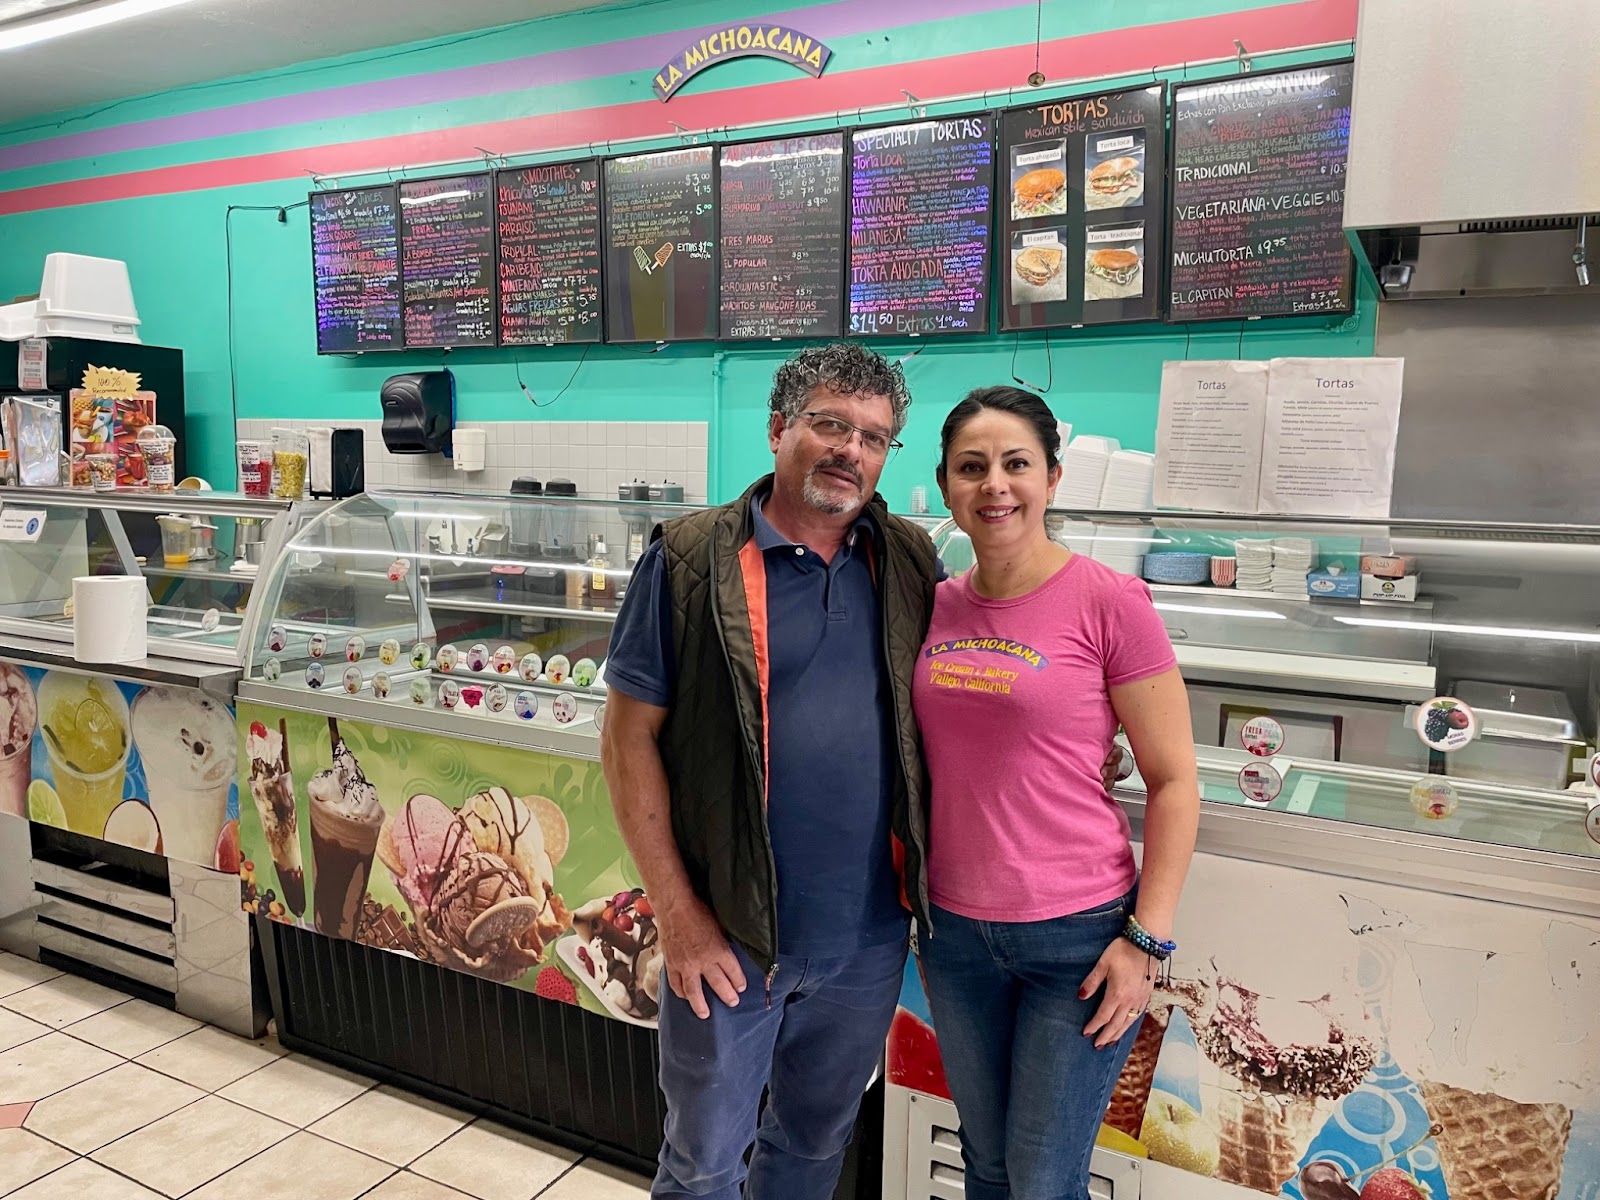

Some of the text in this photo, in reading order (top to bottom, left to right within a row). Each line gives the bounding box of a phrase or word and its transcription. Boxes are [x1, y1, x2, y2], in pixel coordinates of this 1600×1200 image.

[656, 26, 822, 92] LA MICHOACANA
[1024, 126, 1060, 140] Mexican
[1091, 110, 1144, 130] sandwich
[857, 118, 982, 152] SPECIALTY TORTAS
[1018, 152, 1060, 163] Torta ahogada
[522, 164, 576, 185] SMOOTHIES
[1176, 161, 1258, 185] TRADICIONAL
[1176, 192, 1324, 220] VEGETARIANA VEGGIE
[724, 234, 774, 246] TRES MARIAS
[1109, 230, 1142, 238] tradicional
[733, 258, 768, 268] POPULAR
[1173, 246, 1254, 267] MICHUTORTA
[852, 266, 888, 282] TORTA
[890, 258, 943, 280] AHOGADA
[1172, 286, 1234, 304] EL CAPITAN
[730, 326, 756, 338] EXTRAS
[896, 314, 936, 332] Extras
[1198, 380, 1226, 391] Tortas
[1316, 378, 1355, 389] Tortas
[931, 638, 1042, 668] LA MICHOACANA
[930, 660, 944, 672] Ice
[945, 662, 974, 676] Cream
[984, 666, 1019, 682] Bakery
[964, 678, 1011, 695] California
[1448, 731, 1464, 740] MORAS
[1448, 736, 1468, 746] BERRIES
